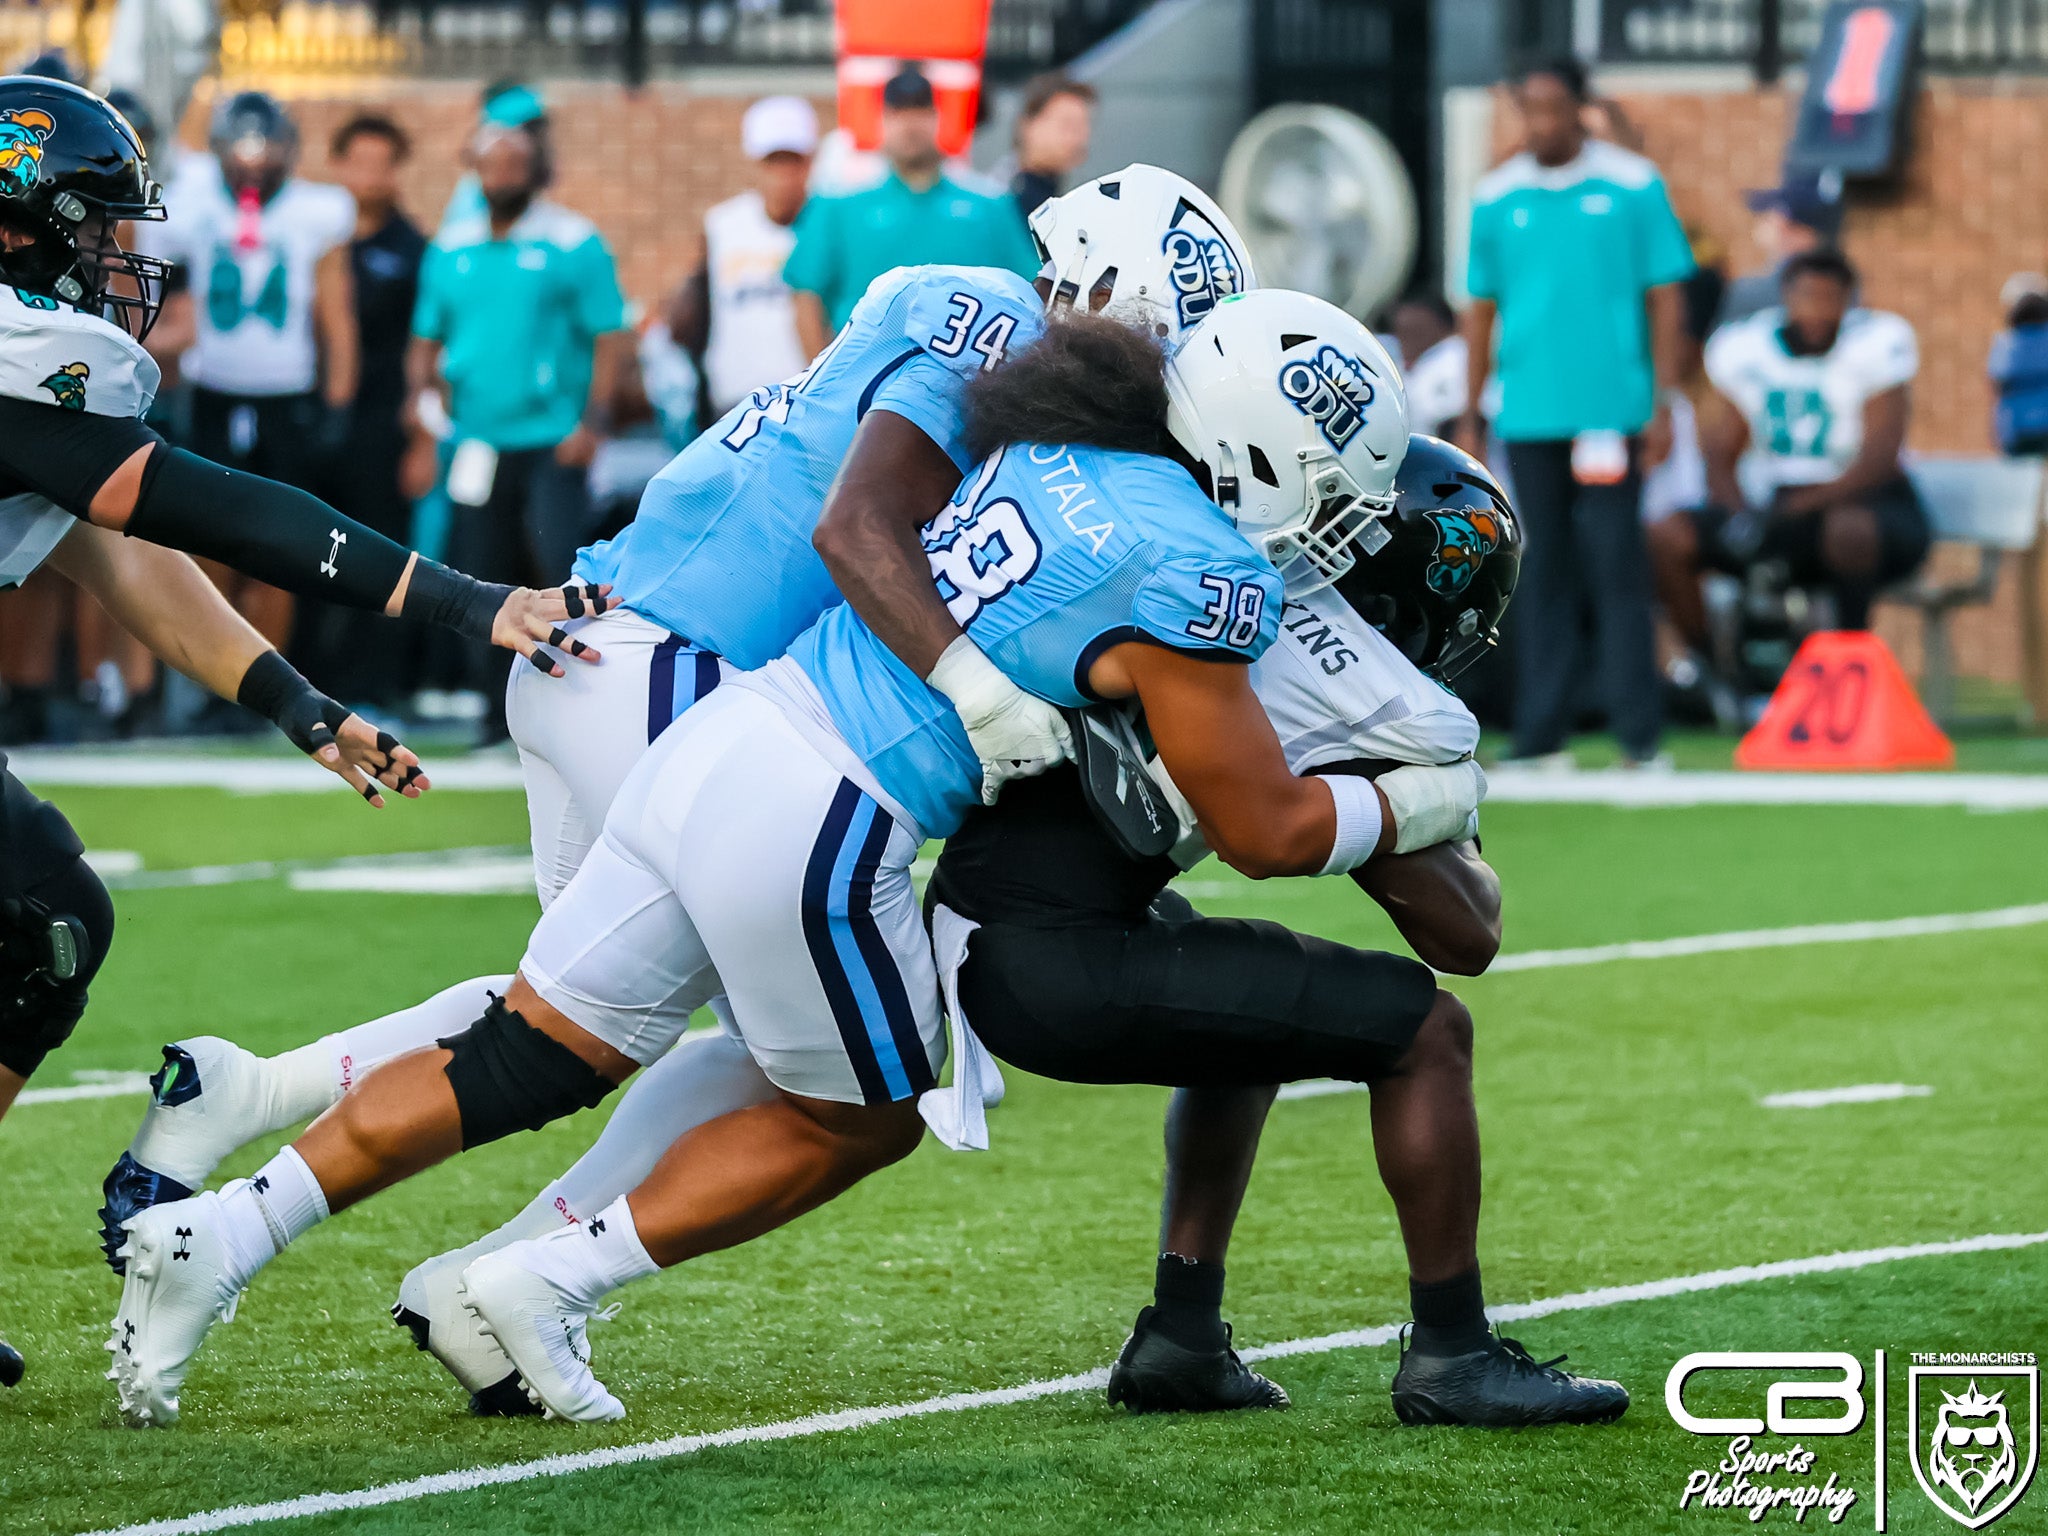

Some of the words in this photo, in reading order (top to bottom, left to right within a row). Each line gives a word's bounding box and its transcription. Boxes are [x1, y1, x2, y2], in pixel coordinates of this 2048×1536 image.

[1163, 230, 1216, 329] ODU
[928, 291, 1019, 373] 34
[1280, 361, 1363, 450] ODU
[1184, 572, 1266, 649] 38
[1789, 660, 1869, 745] 20
